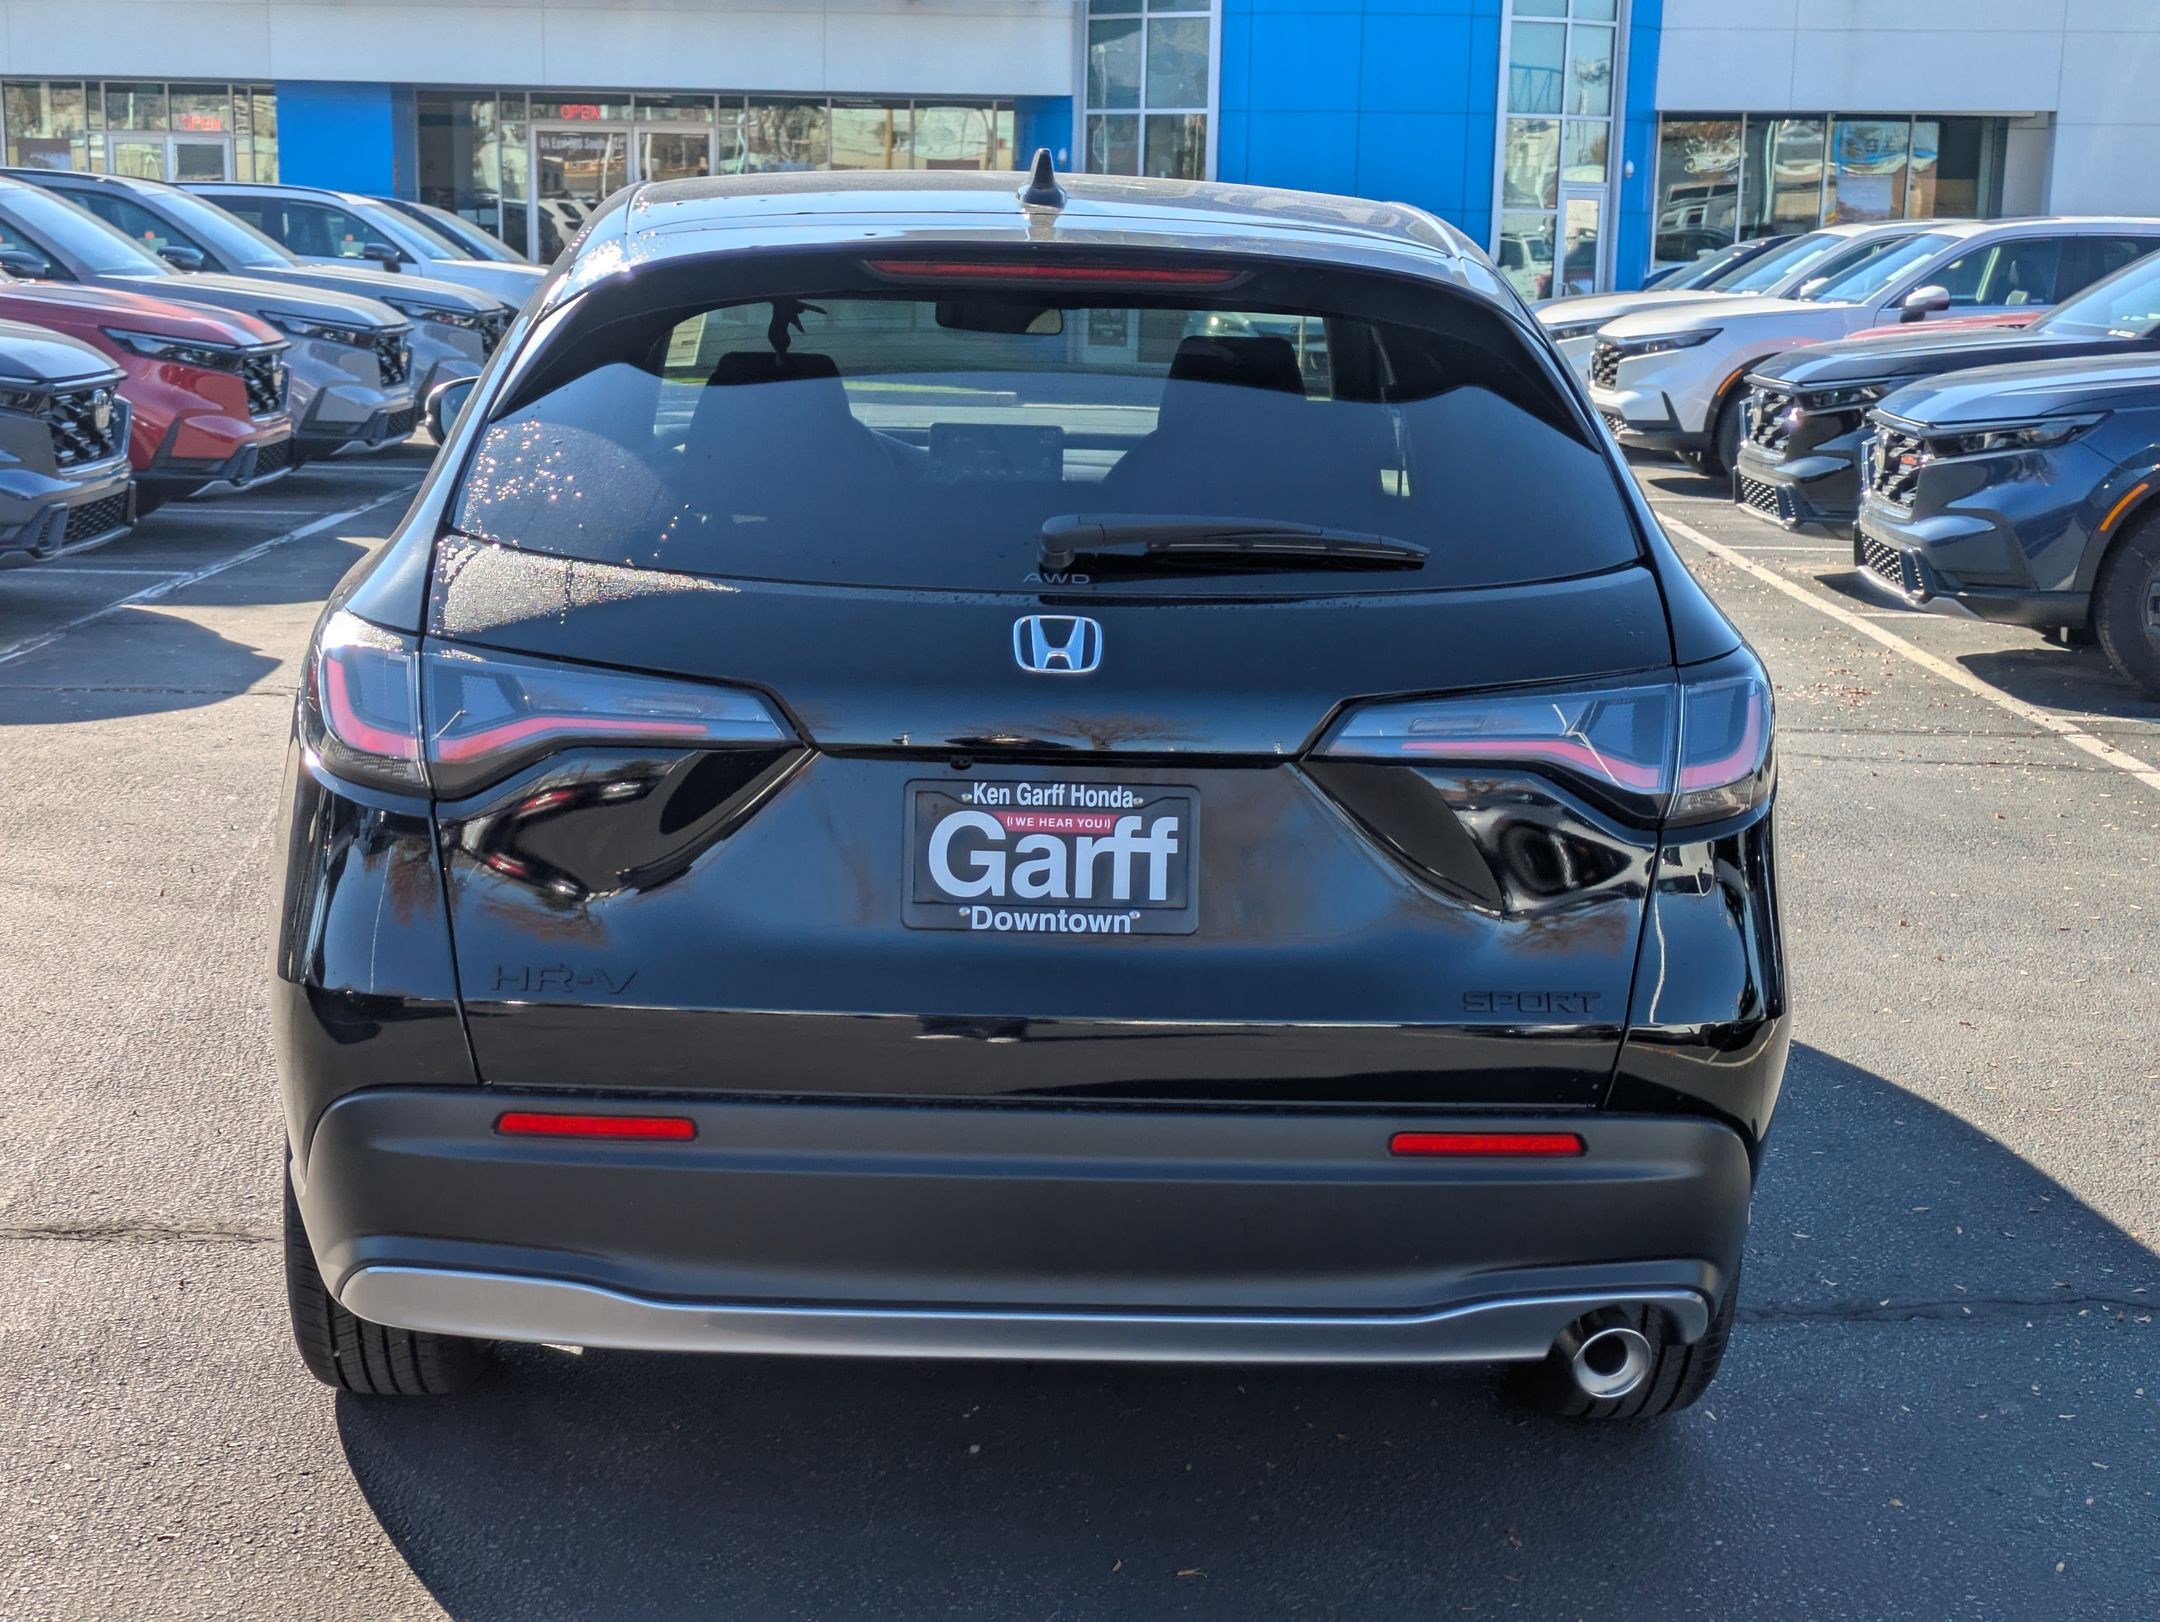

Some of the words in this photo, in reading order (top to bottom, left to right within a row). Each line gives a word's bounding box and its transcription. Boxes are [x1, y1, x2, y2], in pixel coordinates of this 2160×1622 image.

[560, 104, 601, 120] OPEN
[1023, 572, 1090, 584] AWD
[973, 783, 1010, 805] Ken
[1017, 783, 1066, 806] Garff
[1071, 784, 1134, 808] Honda
[1039, 818, 1073, 828] HEAR
[928, 810, 1178, 901] Garff
[971, 906, 1131, 933] Downtown
[490, 963, 638, 995] HR-V
[1462, 989, 1601, 1014] SPORT
